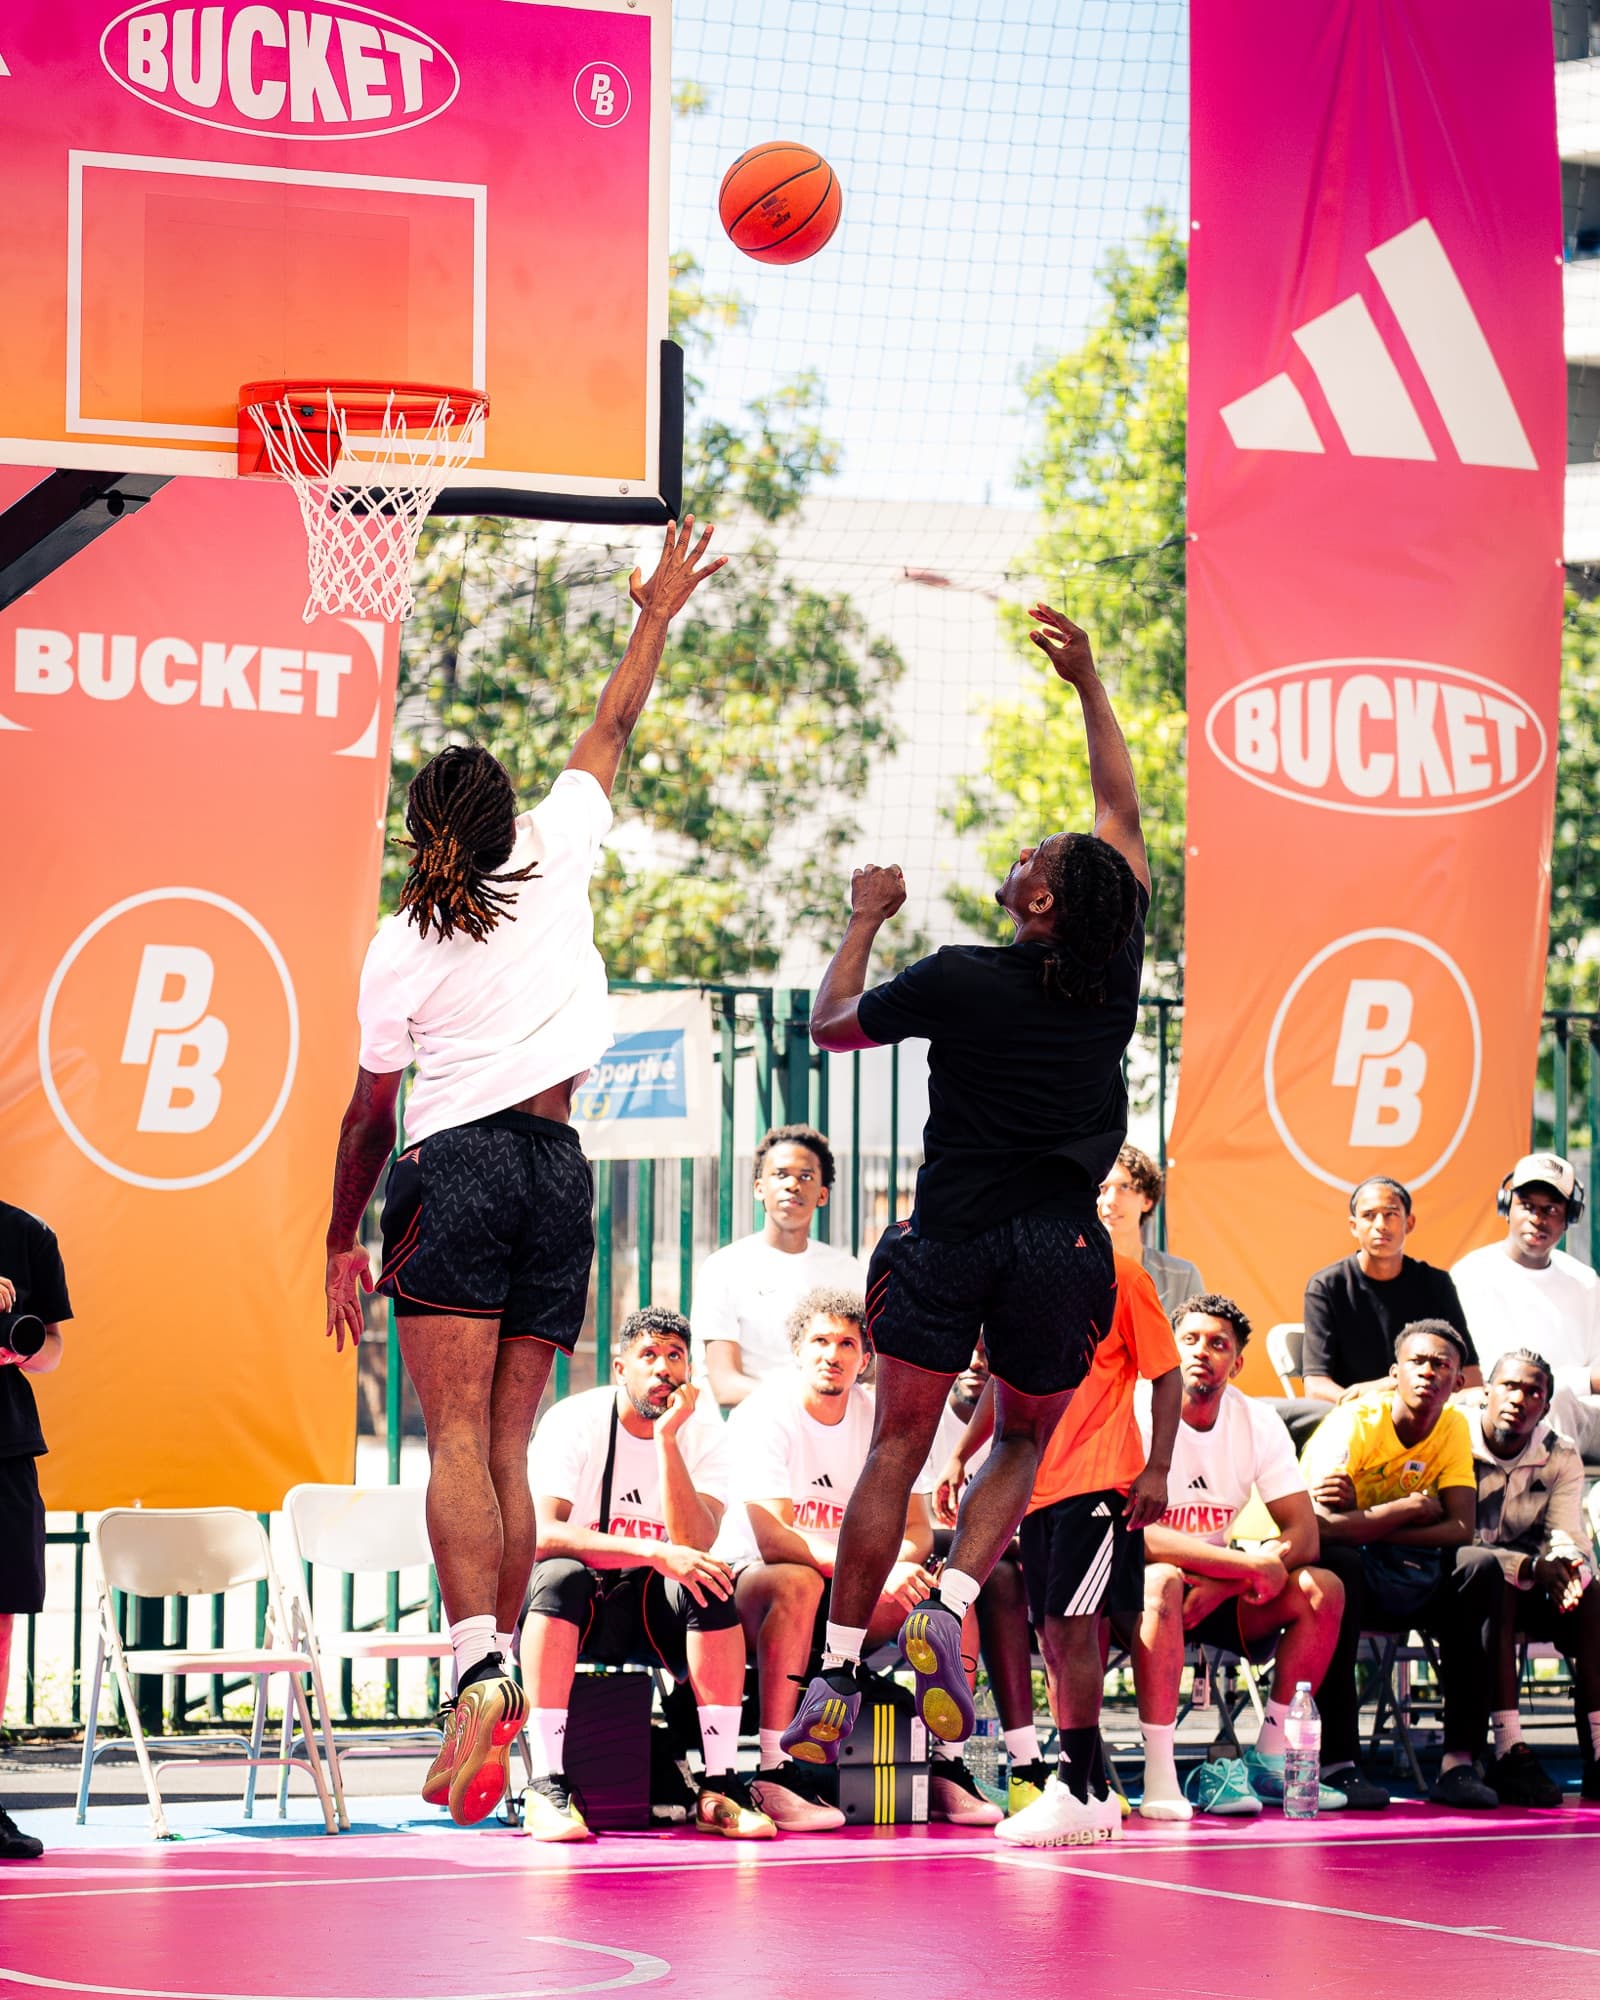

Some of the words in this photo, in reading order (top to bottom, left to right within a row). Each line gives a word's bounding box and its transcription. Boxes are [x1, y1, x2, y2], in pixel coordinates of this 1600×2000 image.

[128, 5, 434, 122] BUCKET
[590, 73, 615, 116] PB
[15, 627, 352, 718] BUCKET
[1234, 674, 1527, 798] BUCKET
[121, 944, 229, 1134] PB
[1331, 979, 1427, 1147] PB
